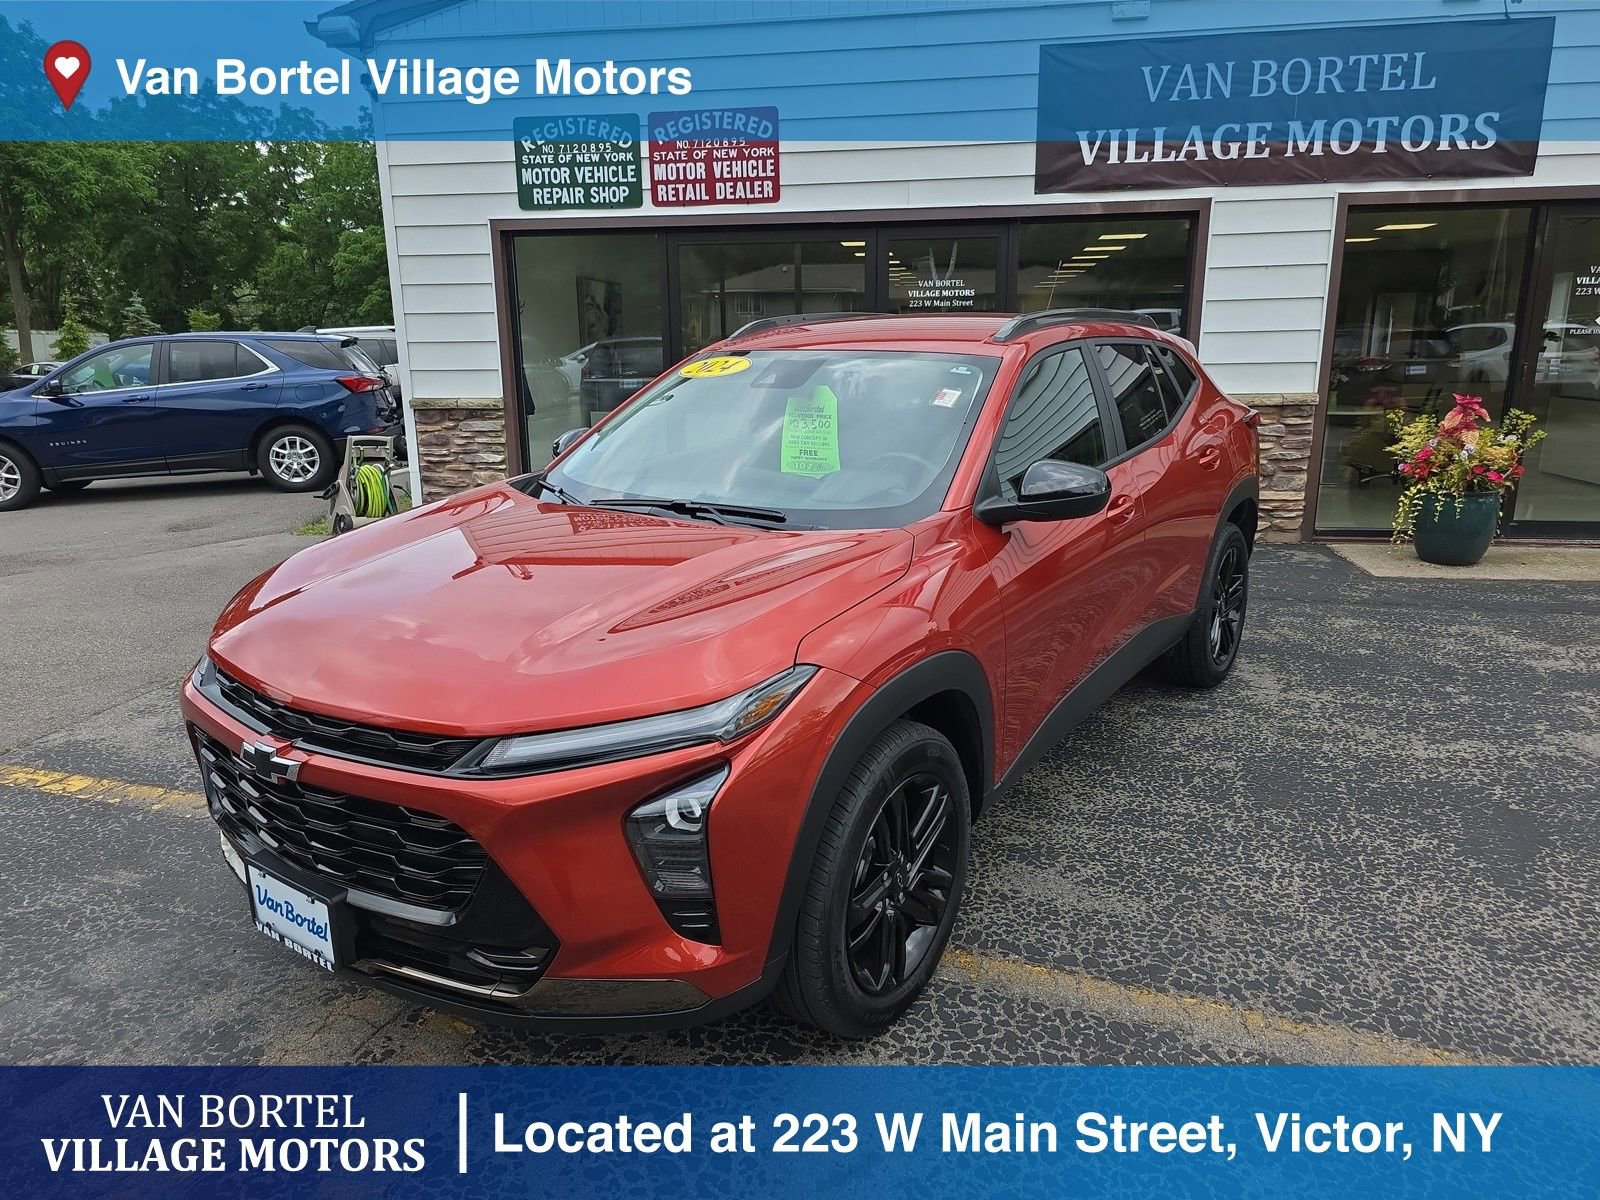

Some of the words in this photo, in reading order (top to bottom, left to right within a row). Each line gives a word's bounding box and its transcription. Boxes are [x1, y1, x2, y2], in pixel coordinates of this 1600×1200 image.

[1141, 61, 1236, 103] VAN
[1249, 51, 1437, 98] BORTEL
[520, 117, 633, 153] REGISTERED
[654, 111, 773, 145] REGISTERED
[559, 142, 613, 153] 7120895
[676, 140, 690, 149] NO.
[693, 137, 746, 148] 7120895
[1075, 121, 1272, 166] VILLAGE
[1283, 111, 1501, 158] MOTORS
[522, 155, 554, 164] STATE
[558, 154, 573, 164] OF
[576, 153, 601, 163] NEW
[604, 152, 634, 162] YORK
[653, 151, 688, 161] STATE
[693, 150, 708, 160] OF
[713, 149, 738, 159] NEW
[743, 147, 775, 157] YORK
[522, 167, 571, 185] MOTOR
[574, 165, 637, 183] VEHICLE
[654, 162, 706, 181] MOTOR
[712, 159, 775, 179] VEHICLE
[533, 187, 585, 205] REPAIR
[590, 186, 629, 204] SHOP
[657, 183, 710, 202] RETAIL
[715, 180, 773, 200] DEALER
[918, 280, 934, 288] VAN
[935, 279, 965, 287] BORTEL
[941, 289, 975, 297] MOTORS
[1575, 287, 1592, 296] 223
[952, 299, 974, 307] Street
[255, 920, 280, 942] VAN
[284, 937, 335, 973] BORTEL
